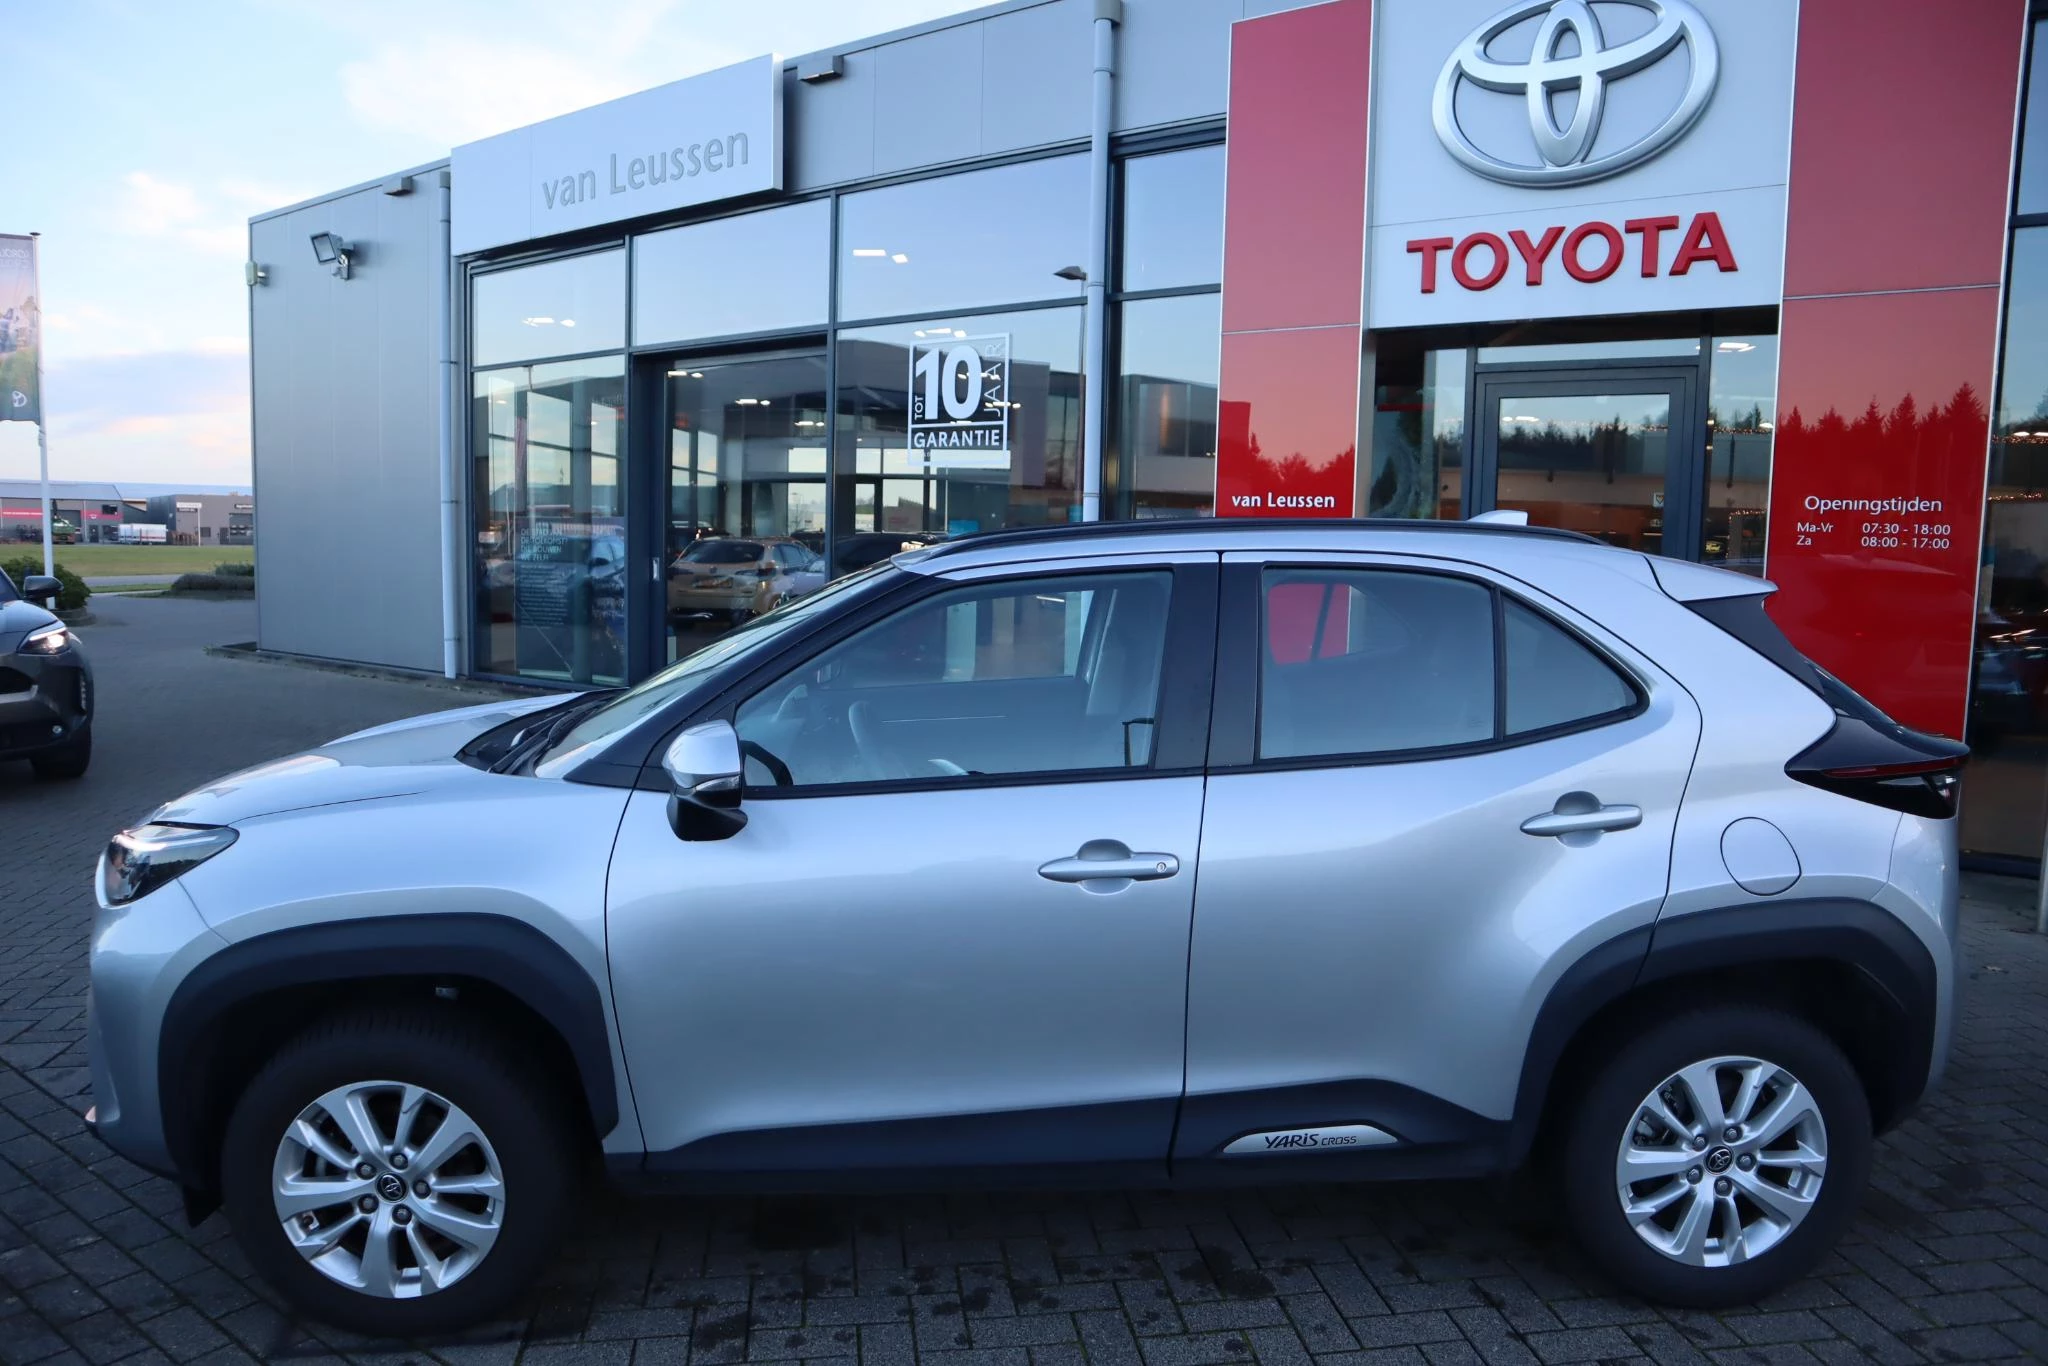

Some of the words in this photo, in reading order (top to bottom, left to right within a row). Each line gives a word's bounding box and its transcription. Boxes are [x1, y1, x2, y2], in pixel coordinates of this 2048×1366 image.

[542, 169, 596, 210] van
[609, 132, 749, 195] Leussen
[1406, 211, 1739, 294] TOYOTA
[915, 345, 982, 420] 10
[984, 343, 1001, 417] JAAR
[914, 395, 924, 420] TOT
[913, 429, 1000, 448] GARANTIE
[1232, 495, 1261, 507] van
[1267, 491, 1335, 508] Leussen
[1804, 495, 1943, 515] Openingstijden
[1797, 522, 1833, 533] Ma-Vr
[1862, 522, 1900, 534] 07:30
[1913, 523, 1951, 535] 18:00
[1796, 535, 1812, 546] Za
[1861, 536, 1898, 548] 08:00
[1912, 537, 1950, 549] 17:00
[1321, 1135, 1357, 1146] CROSS
